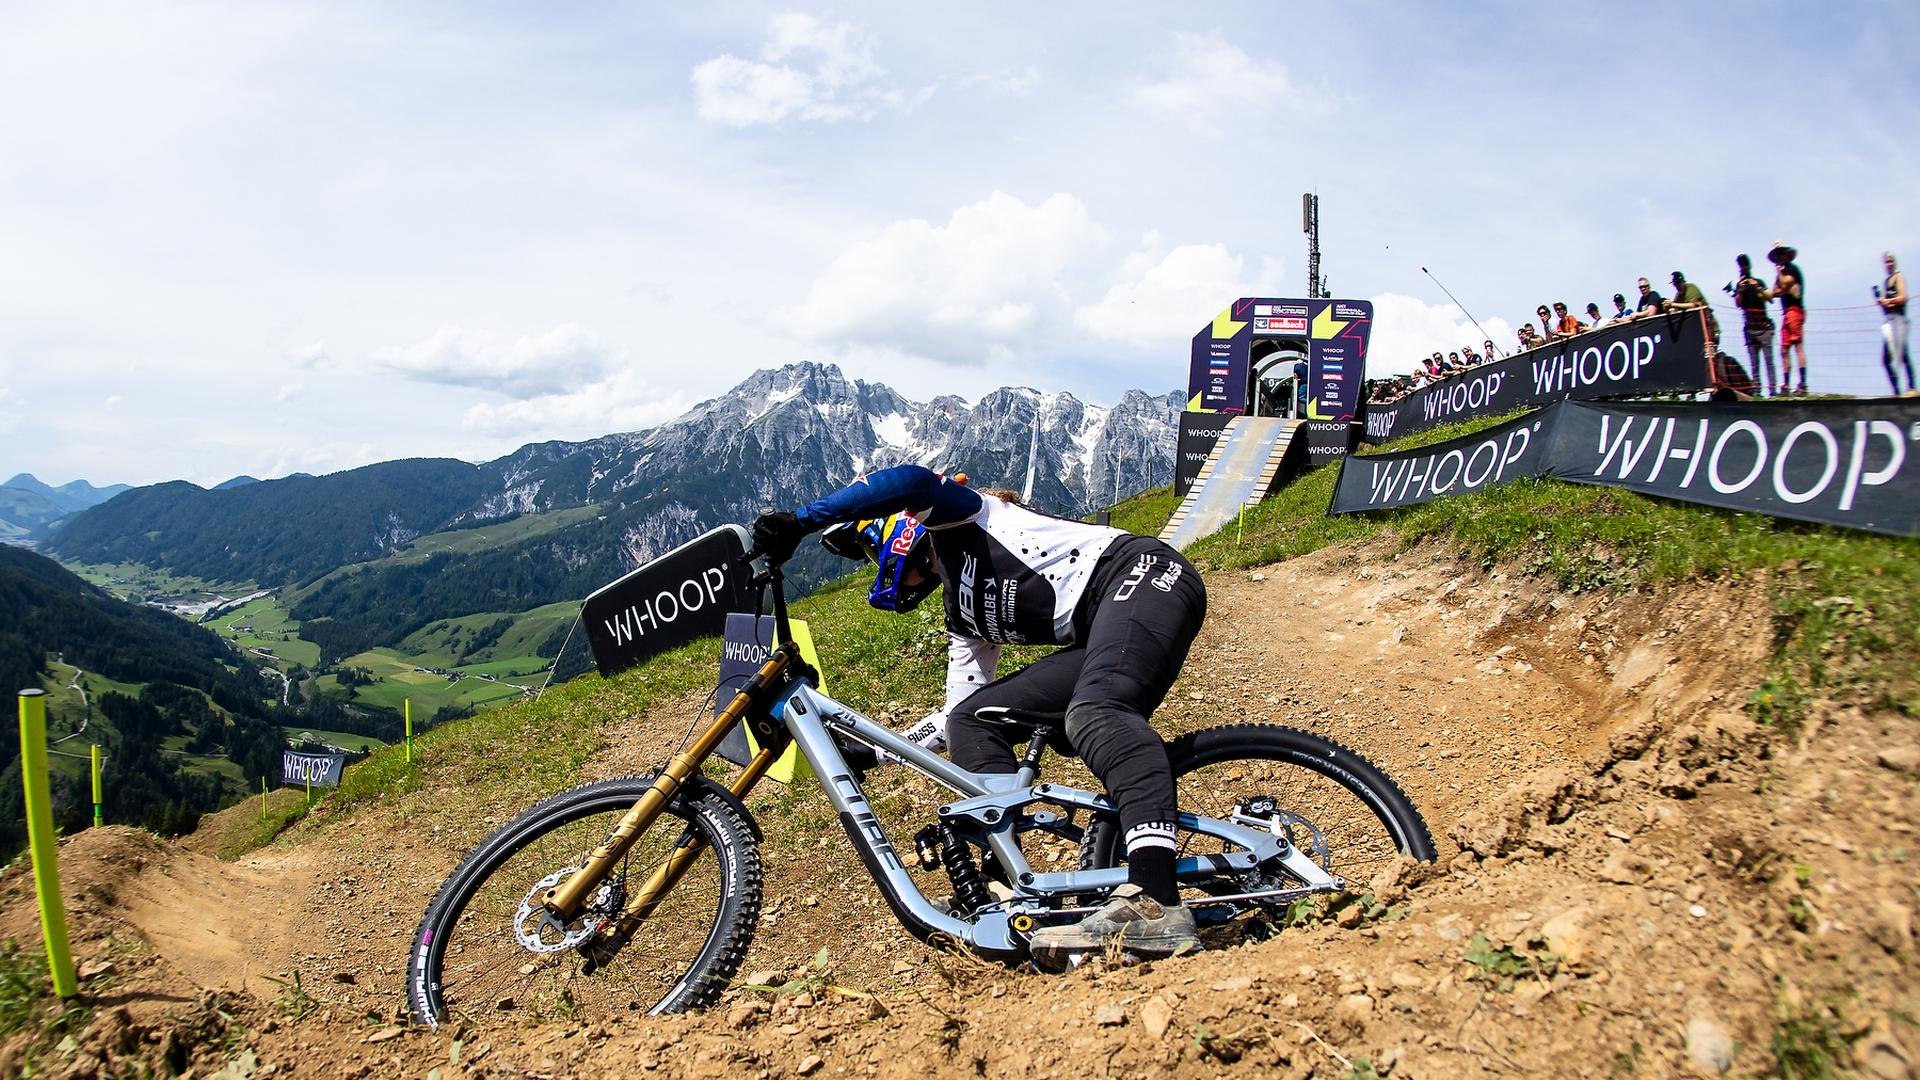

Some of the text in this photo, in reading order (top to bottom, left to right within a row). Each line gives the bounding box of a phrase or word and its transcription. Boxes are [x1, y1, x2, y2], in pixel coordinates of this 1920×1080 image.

[1270, 318, 1304, 329] saalbach
[1185, 453, 1208, 461] WHO
[960, 551, 987, 642] UBE
[1007, 579, 1018, 623] SHIMANO
[702, 809, 737, 898] MAGIC MARY
